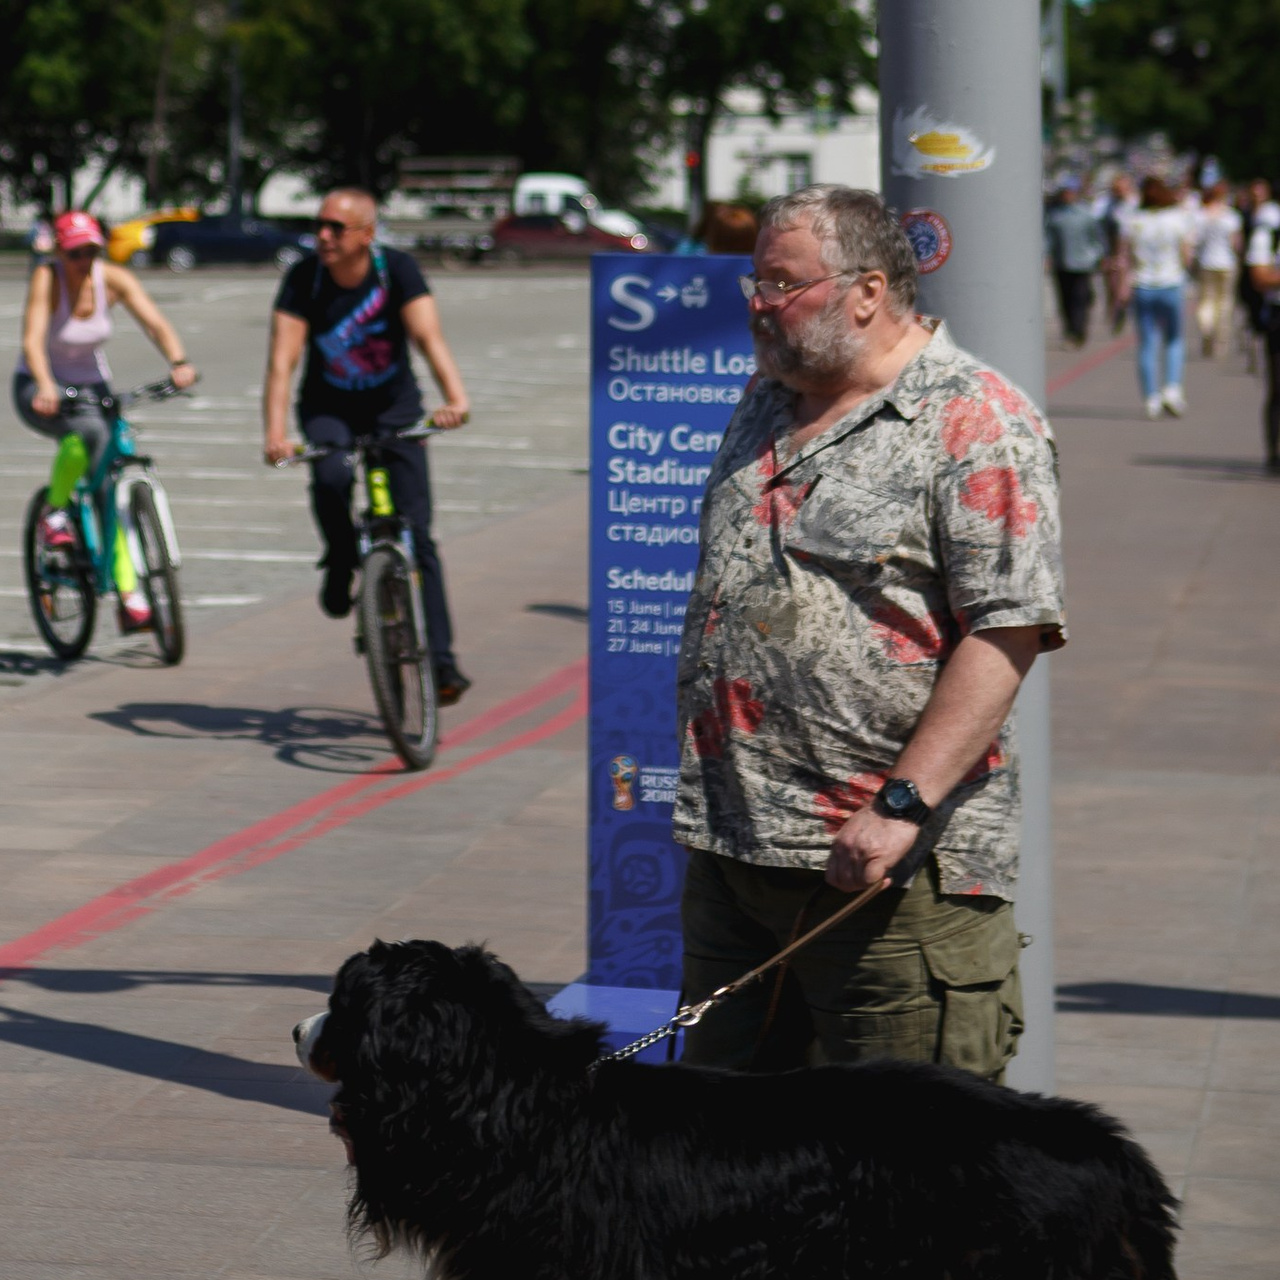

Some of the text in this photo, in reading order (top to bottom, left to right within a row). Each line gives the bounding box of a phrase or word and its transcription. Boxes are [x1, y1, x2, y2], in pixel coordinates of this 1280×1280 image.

[607, 274, 656, 332] S
[608, 347, 757, 376] Shuttle Loa
[608, 379, 742, 405] Остановка
[608, 423, 723, 456] City Cen
[608, 491, 687, 519] Центр
[607, 522, 700, 547] стадио
[607, 568, 695, 592] Schedul
[607, 600, 625, 615] 15
[628, 600, 662, 616] June
[607, 618, 685, 636] 21, 24 June
[607, 638, 626, 653] 27
[628, 639, 662, 655] June
